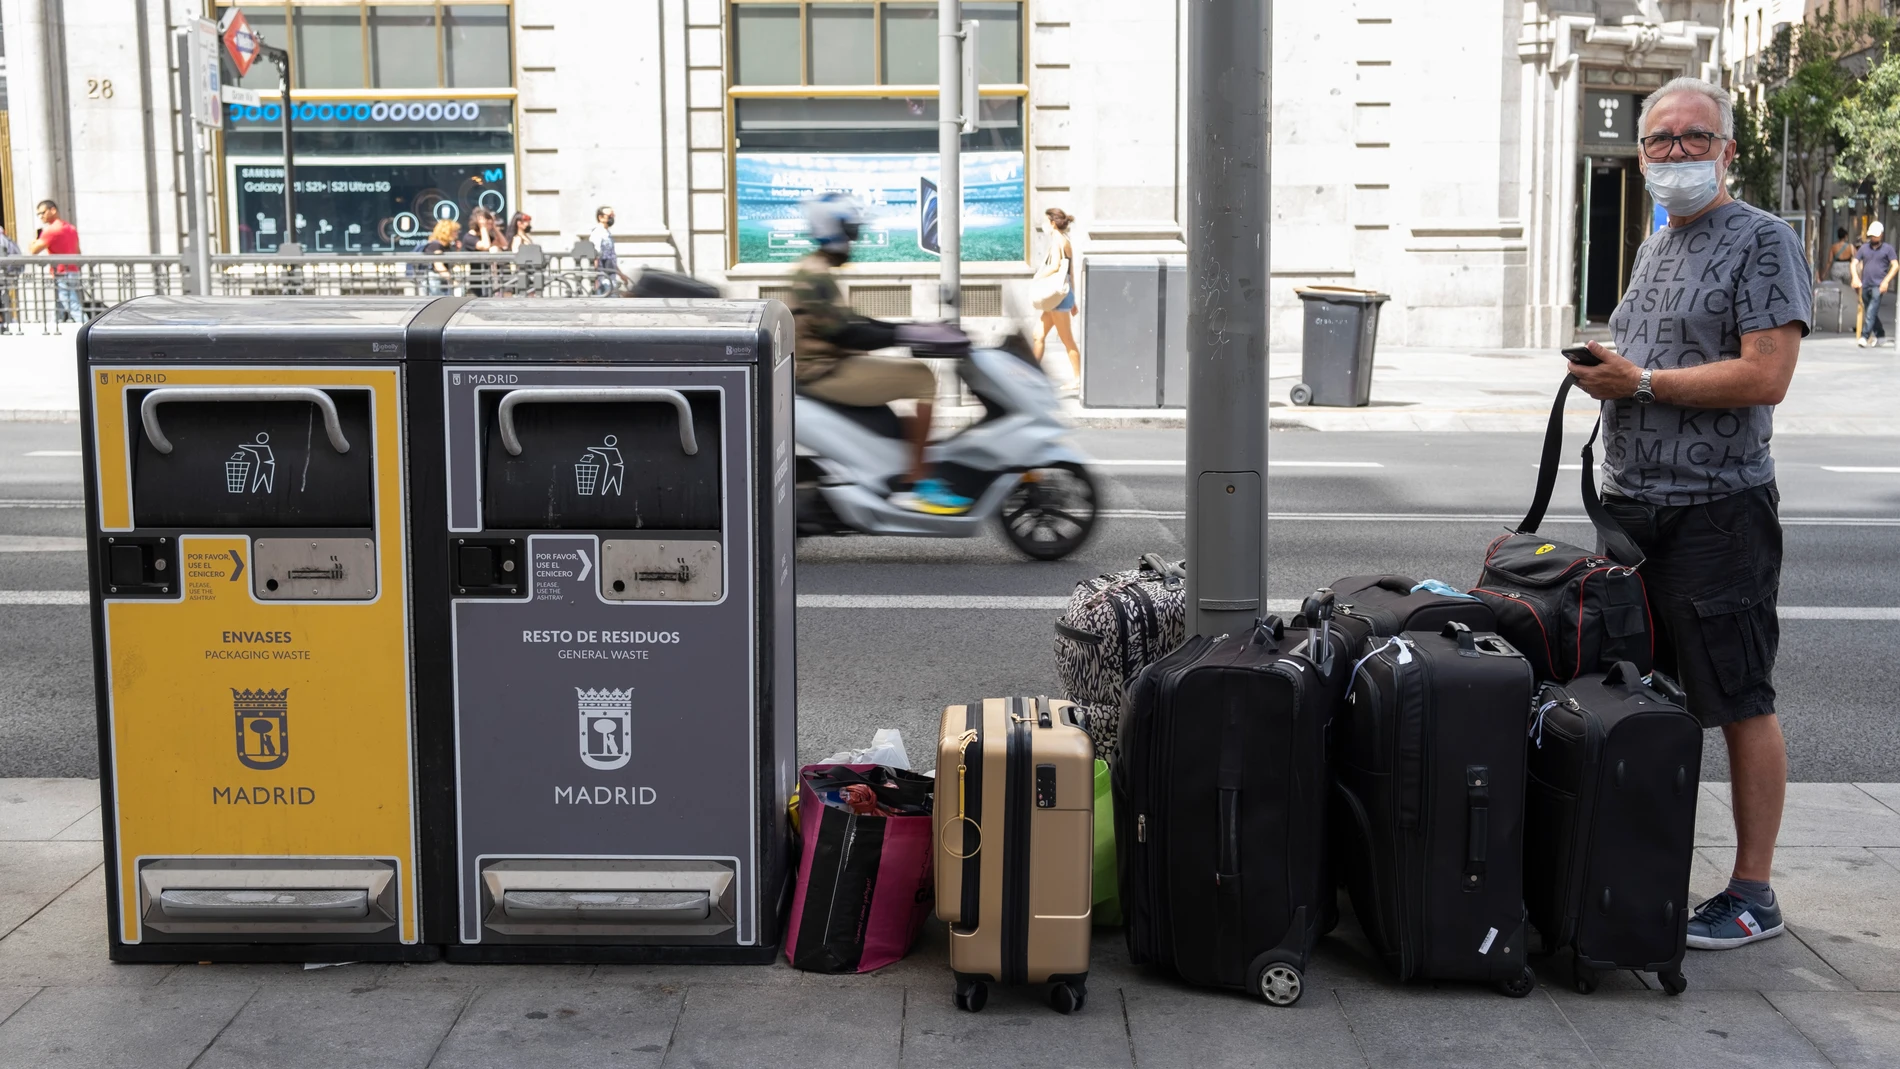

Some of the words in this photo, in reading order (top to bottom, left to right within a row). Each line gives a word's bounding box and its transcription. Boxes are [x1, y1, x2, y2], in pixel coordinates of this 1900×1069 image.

[87, 79, 113, 99] 28
[244, 181, 285, 194] Galaxy
[331, 181, 349, 192] S21
[349, 181, 374, 192] Ultra
[375, 181, 391, 192] 5G
[116, 373, 166, 384] MADRID
[468, 374, 518, 385] MADRID
[536, 570, 573, 578] CENICERO
[222, 631, 292, 644] ENVASES
[522, 630, 573, 643] RESTO
[577, 631, 597, 643] DE
[602, 631, 680, 644] RESIDUOS
[205, 650, 270, 661] PACKAGING
[272, 650, 311, 660] WASTE
[558, 650, 609, 660] GENERAL
[610, 650, 649, 660] WASTE
[212, 786, 316, 806] MADRID
[554, 785, 658, 806] MADRID
